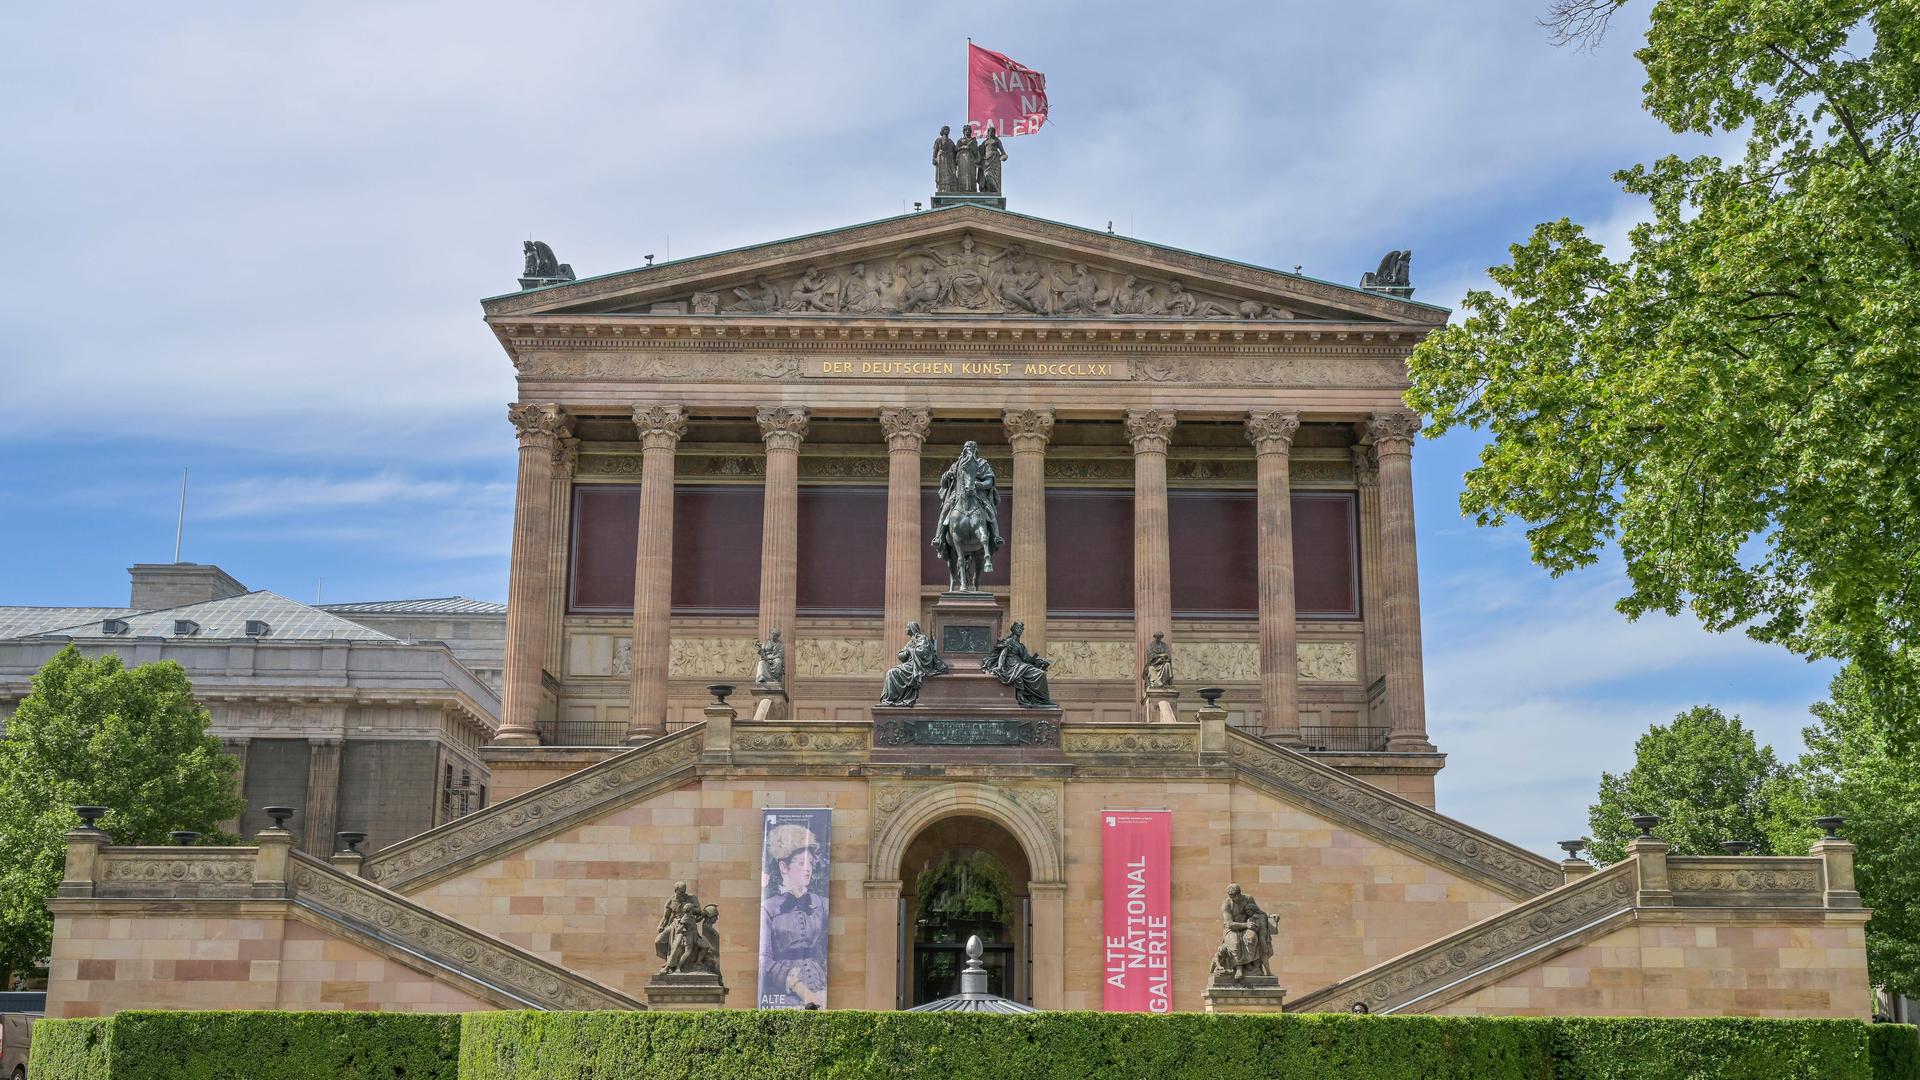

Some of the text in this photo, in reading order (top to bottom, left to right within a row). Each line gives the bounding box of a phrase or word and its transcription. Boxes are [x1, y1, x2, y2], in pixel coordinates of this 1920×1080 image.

[823, 362, 1112, 376] DER DEUTSCHEN KUNST MDCCCLXXI
[1127, 856, 1146, 968] NATIONAL
[1107, 936, 1125, 989] ALTE
[1149, 915, 1168, 1013] GALERIE
[762, 994, 785, 1004] ALTE
